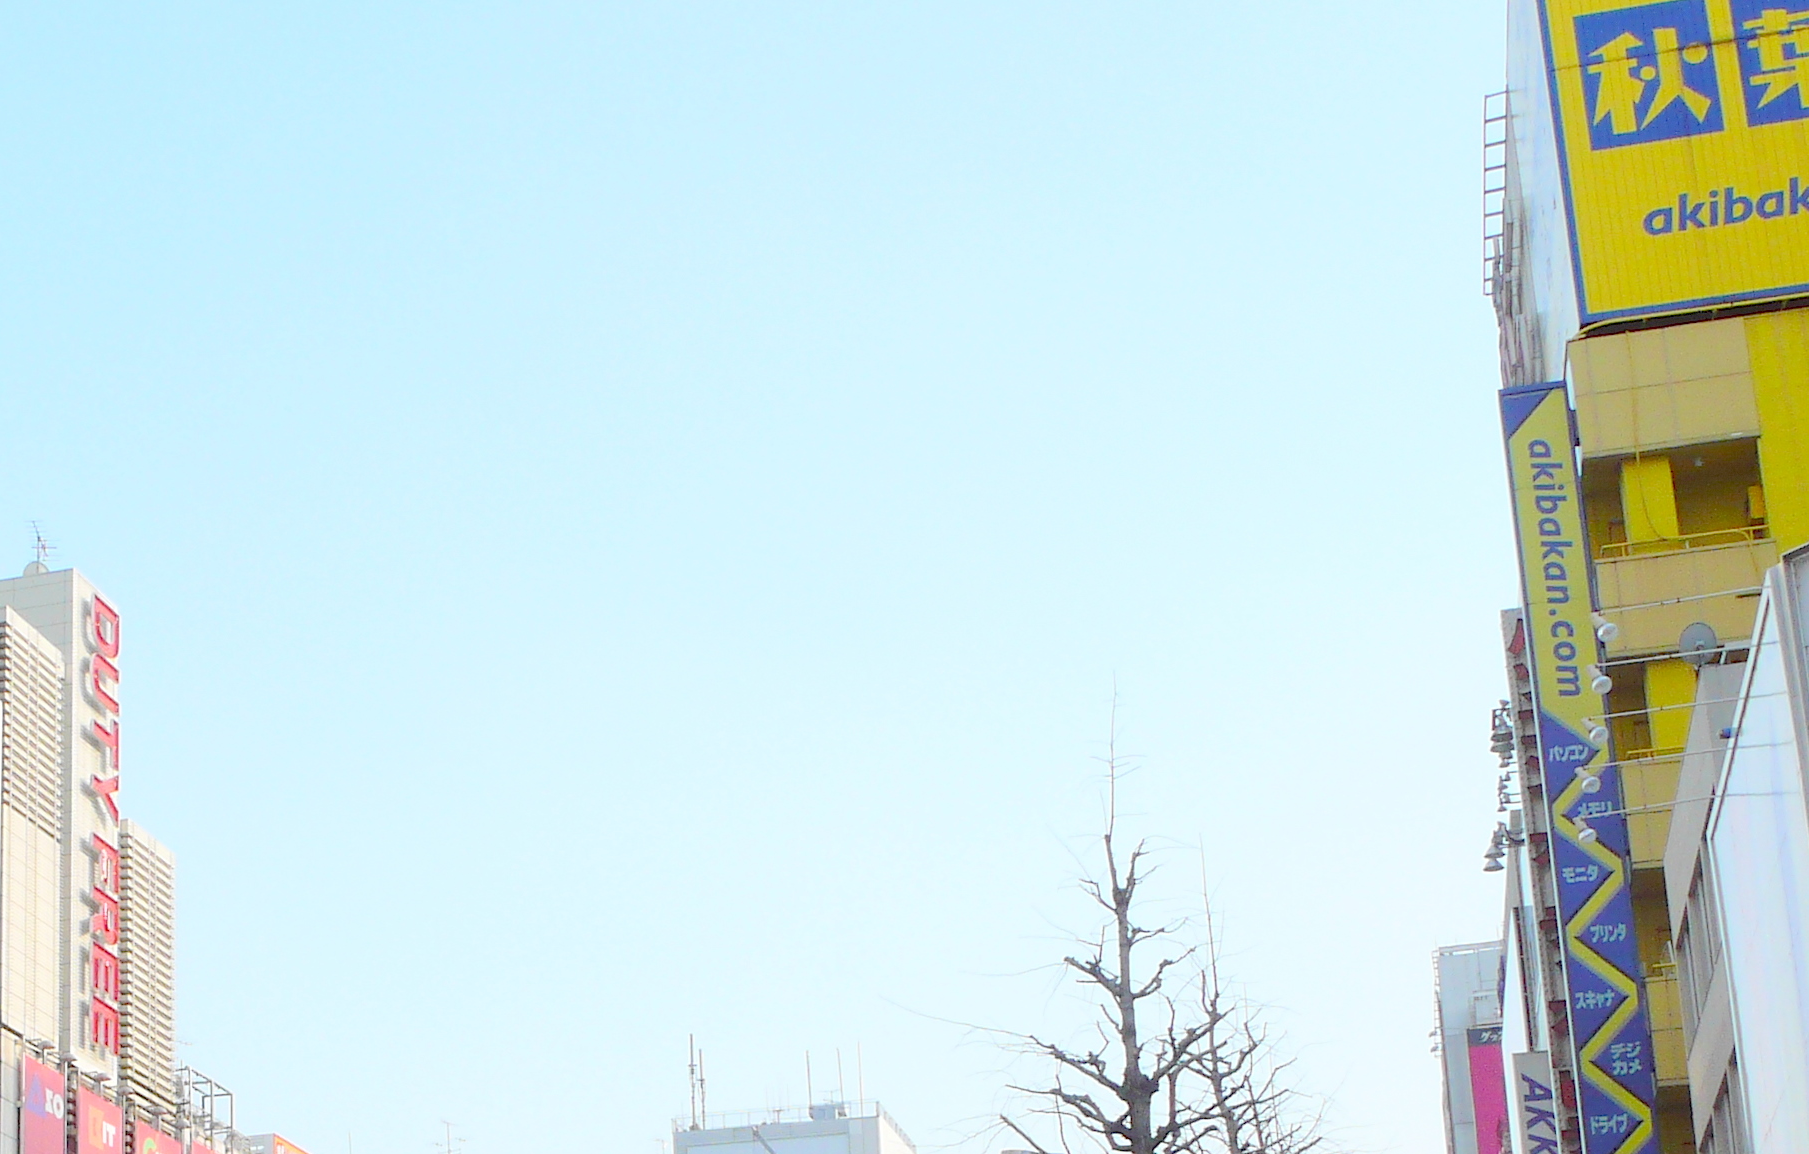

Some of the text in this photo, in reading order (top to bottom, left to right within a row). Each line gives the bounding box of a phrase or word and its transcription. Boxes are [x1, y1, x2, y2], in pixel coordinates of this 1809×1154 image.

[1528, 437, 1580, 698] akibakan.com
[1549, 745, 1589, 762] パソコン
[91, 594, 120, 1056] DUTY FREE
[1562, 865, 1598, 884] モニタ
[1591, 923, 1626, 943] プリンタ
[1575, 990, 1614, 1009] スキャナ
[1591, 1116, 1628, 1135] ドライブ
